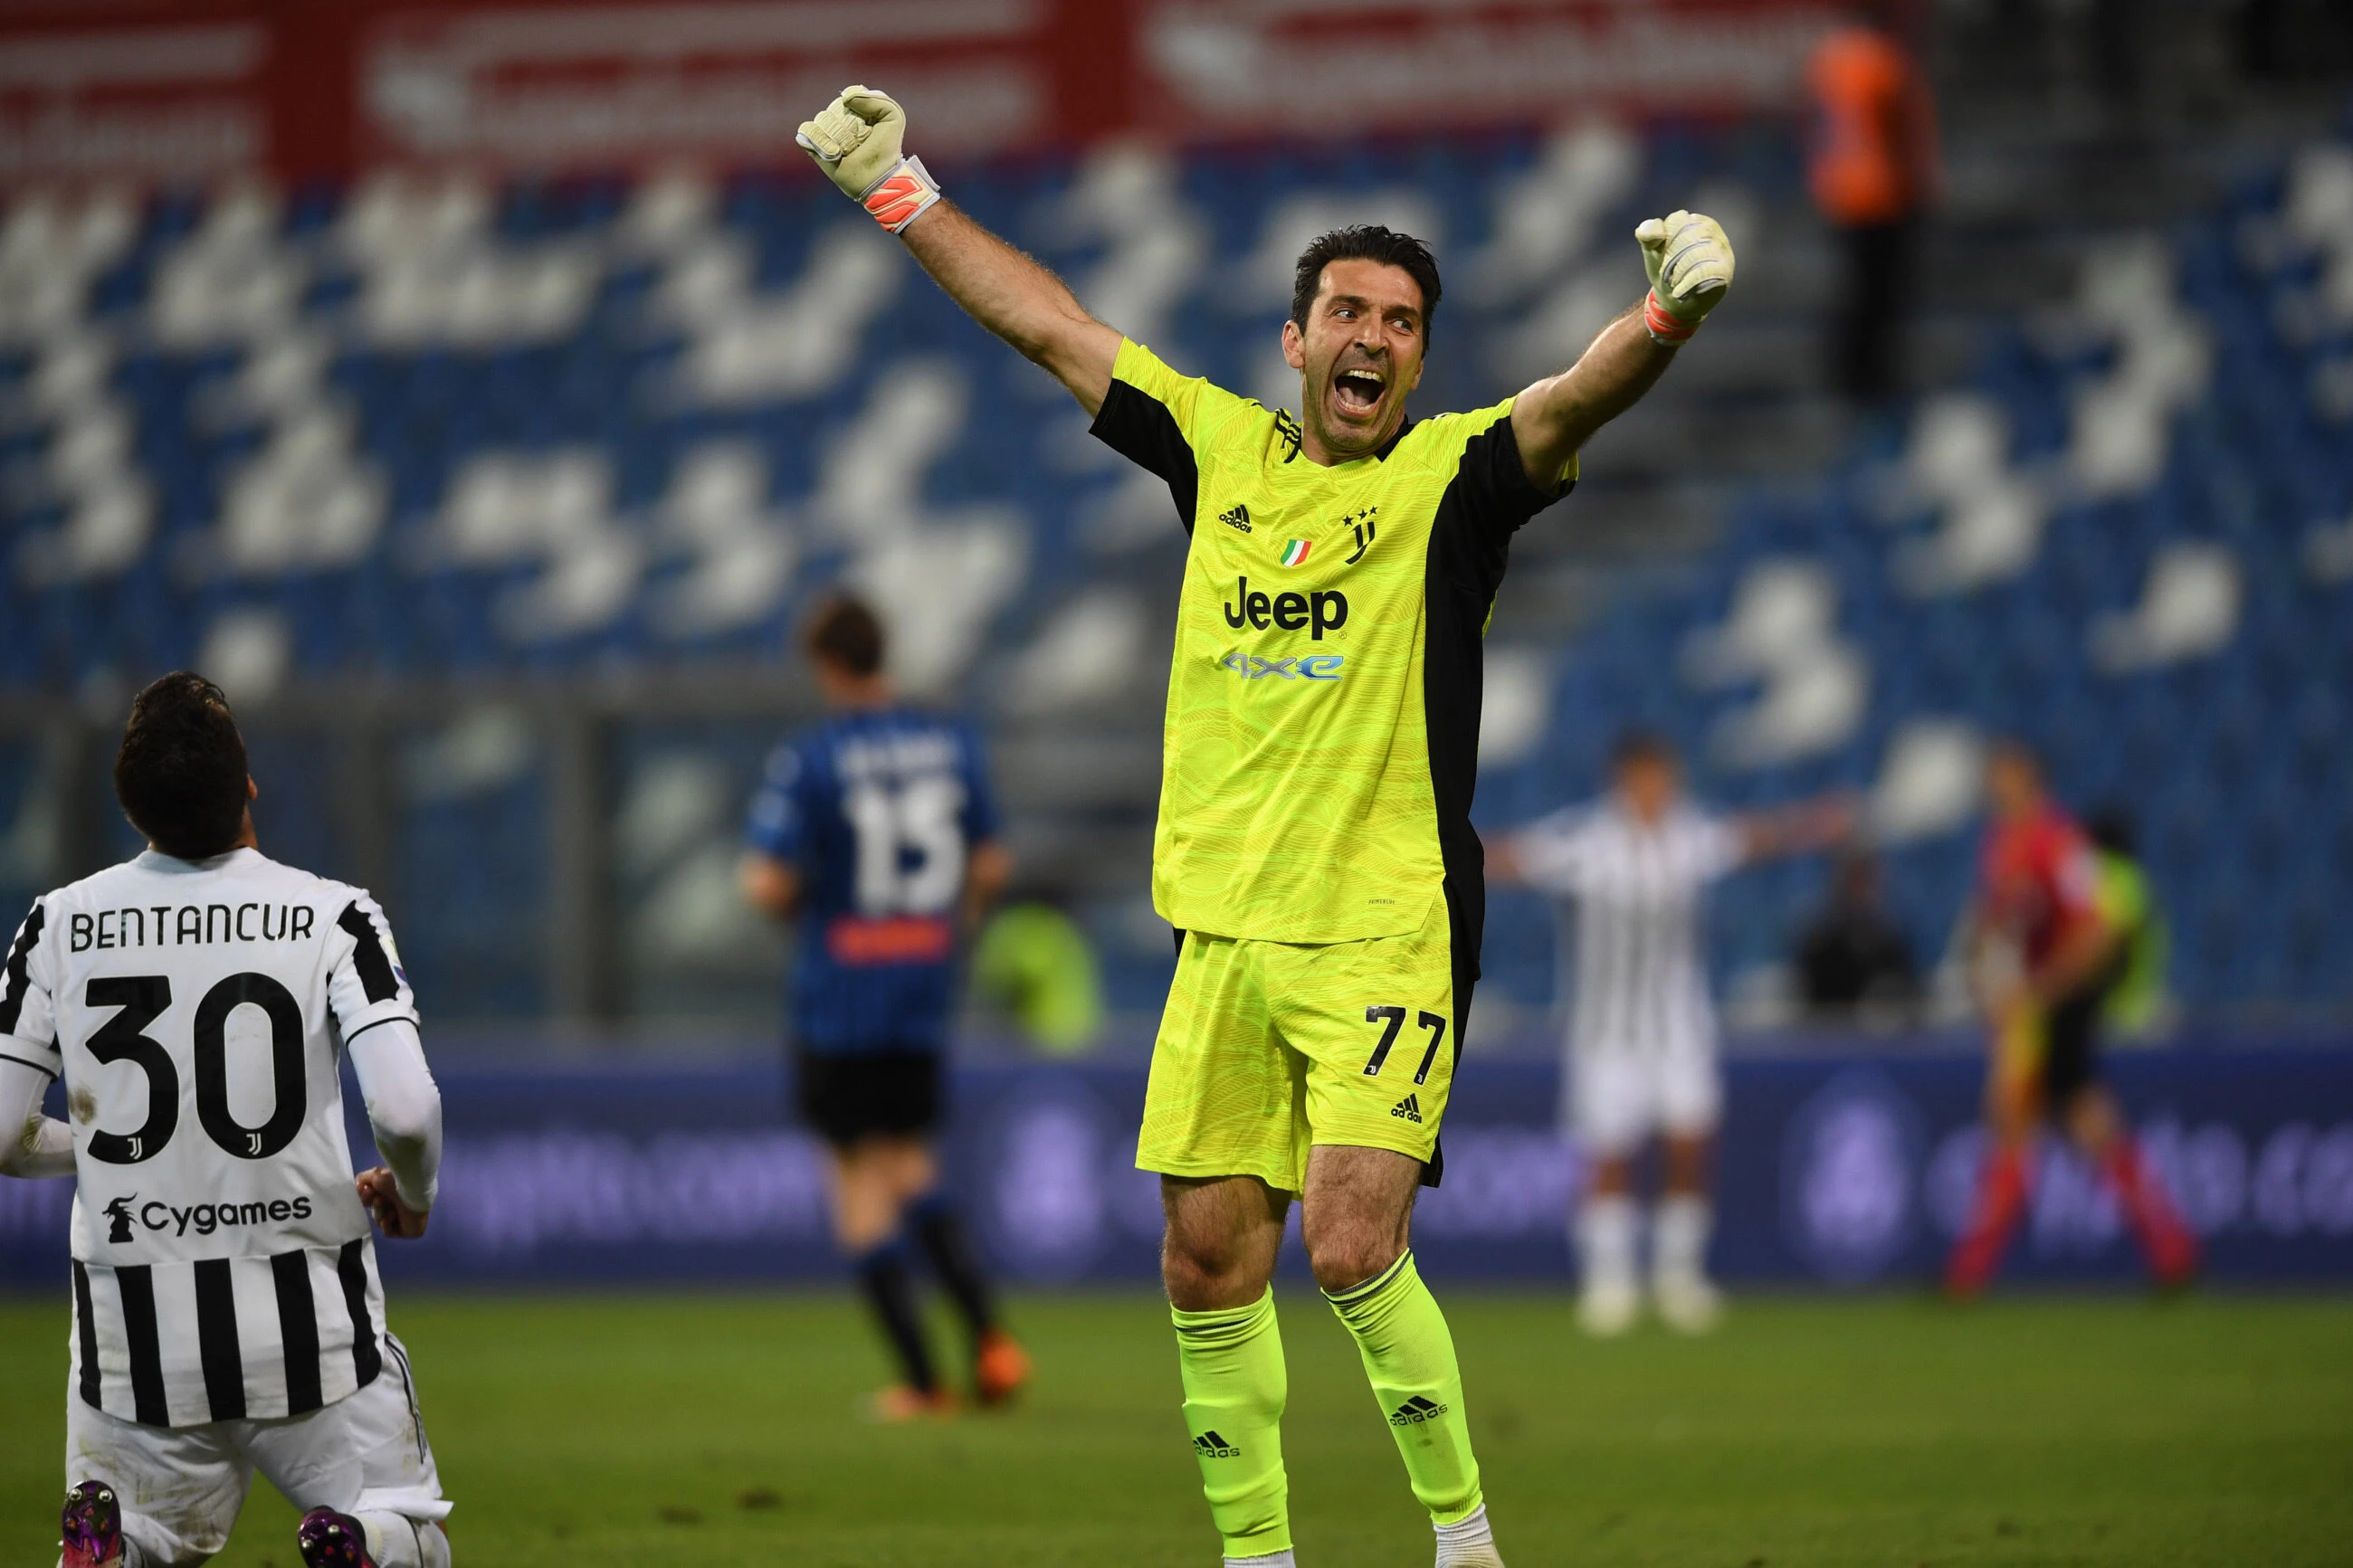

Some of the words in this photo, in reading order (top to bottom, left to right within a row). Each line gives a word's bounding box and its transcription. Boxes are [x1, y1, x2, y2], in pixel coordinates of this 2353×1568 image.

[1218, 514, 1253, 534] adidas
[1224, 575, 1348, 641] Jeep
[71, 903, 314, 953] BENTANCUR
[85, 972, 307, 1164] 30
[1363, 1005, 1446, 1086] 77
[1391, 1107, 1422, 1124] addas
[141, 1196, 312, 1236] Cygames
[1389, 1403, 1448, 1426] adidas
